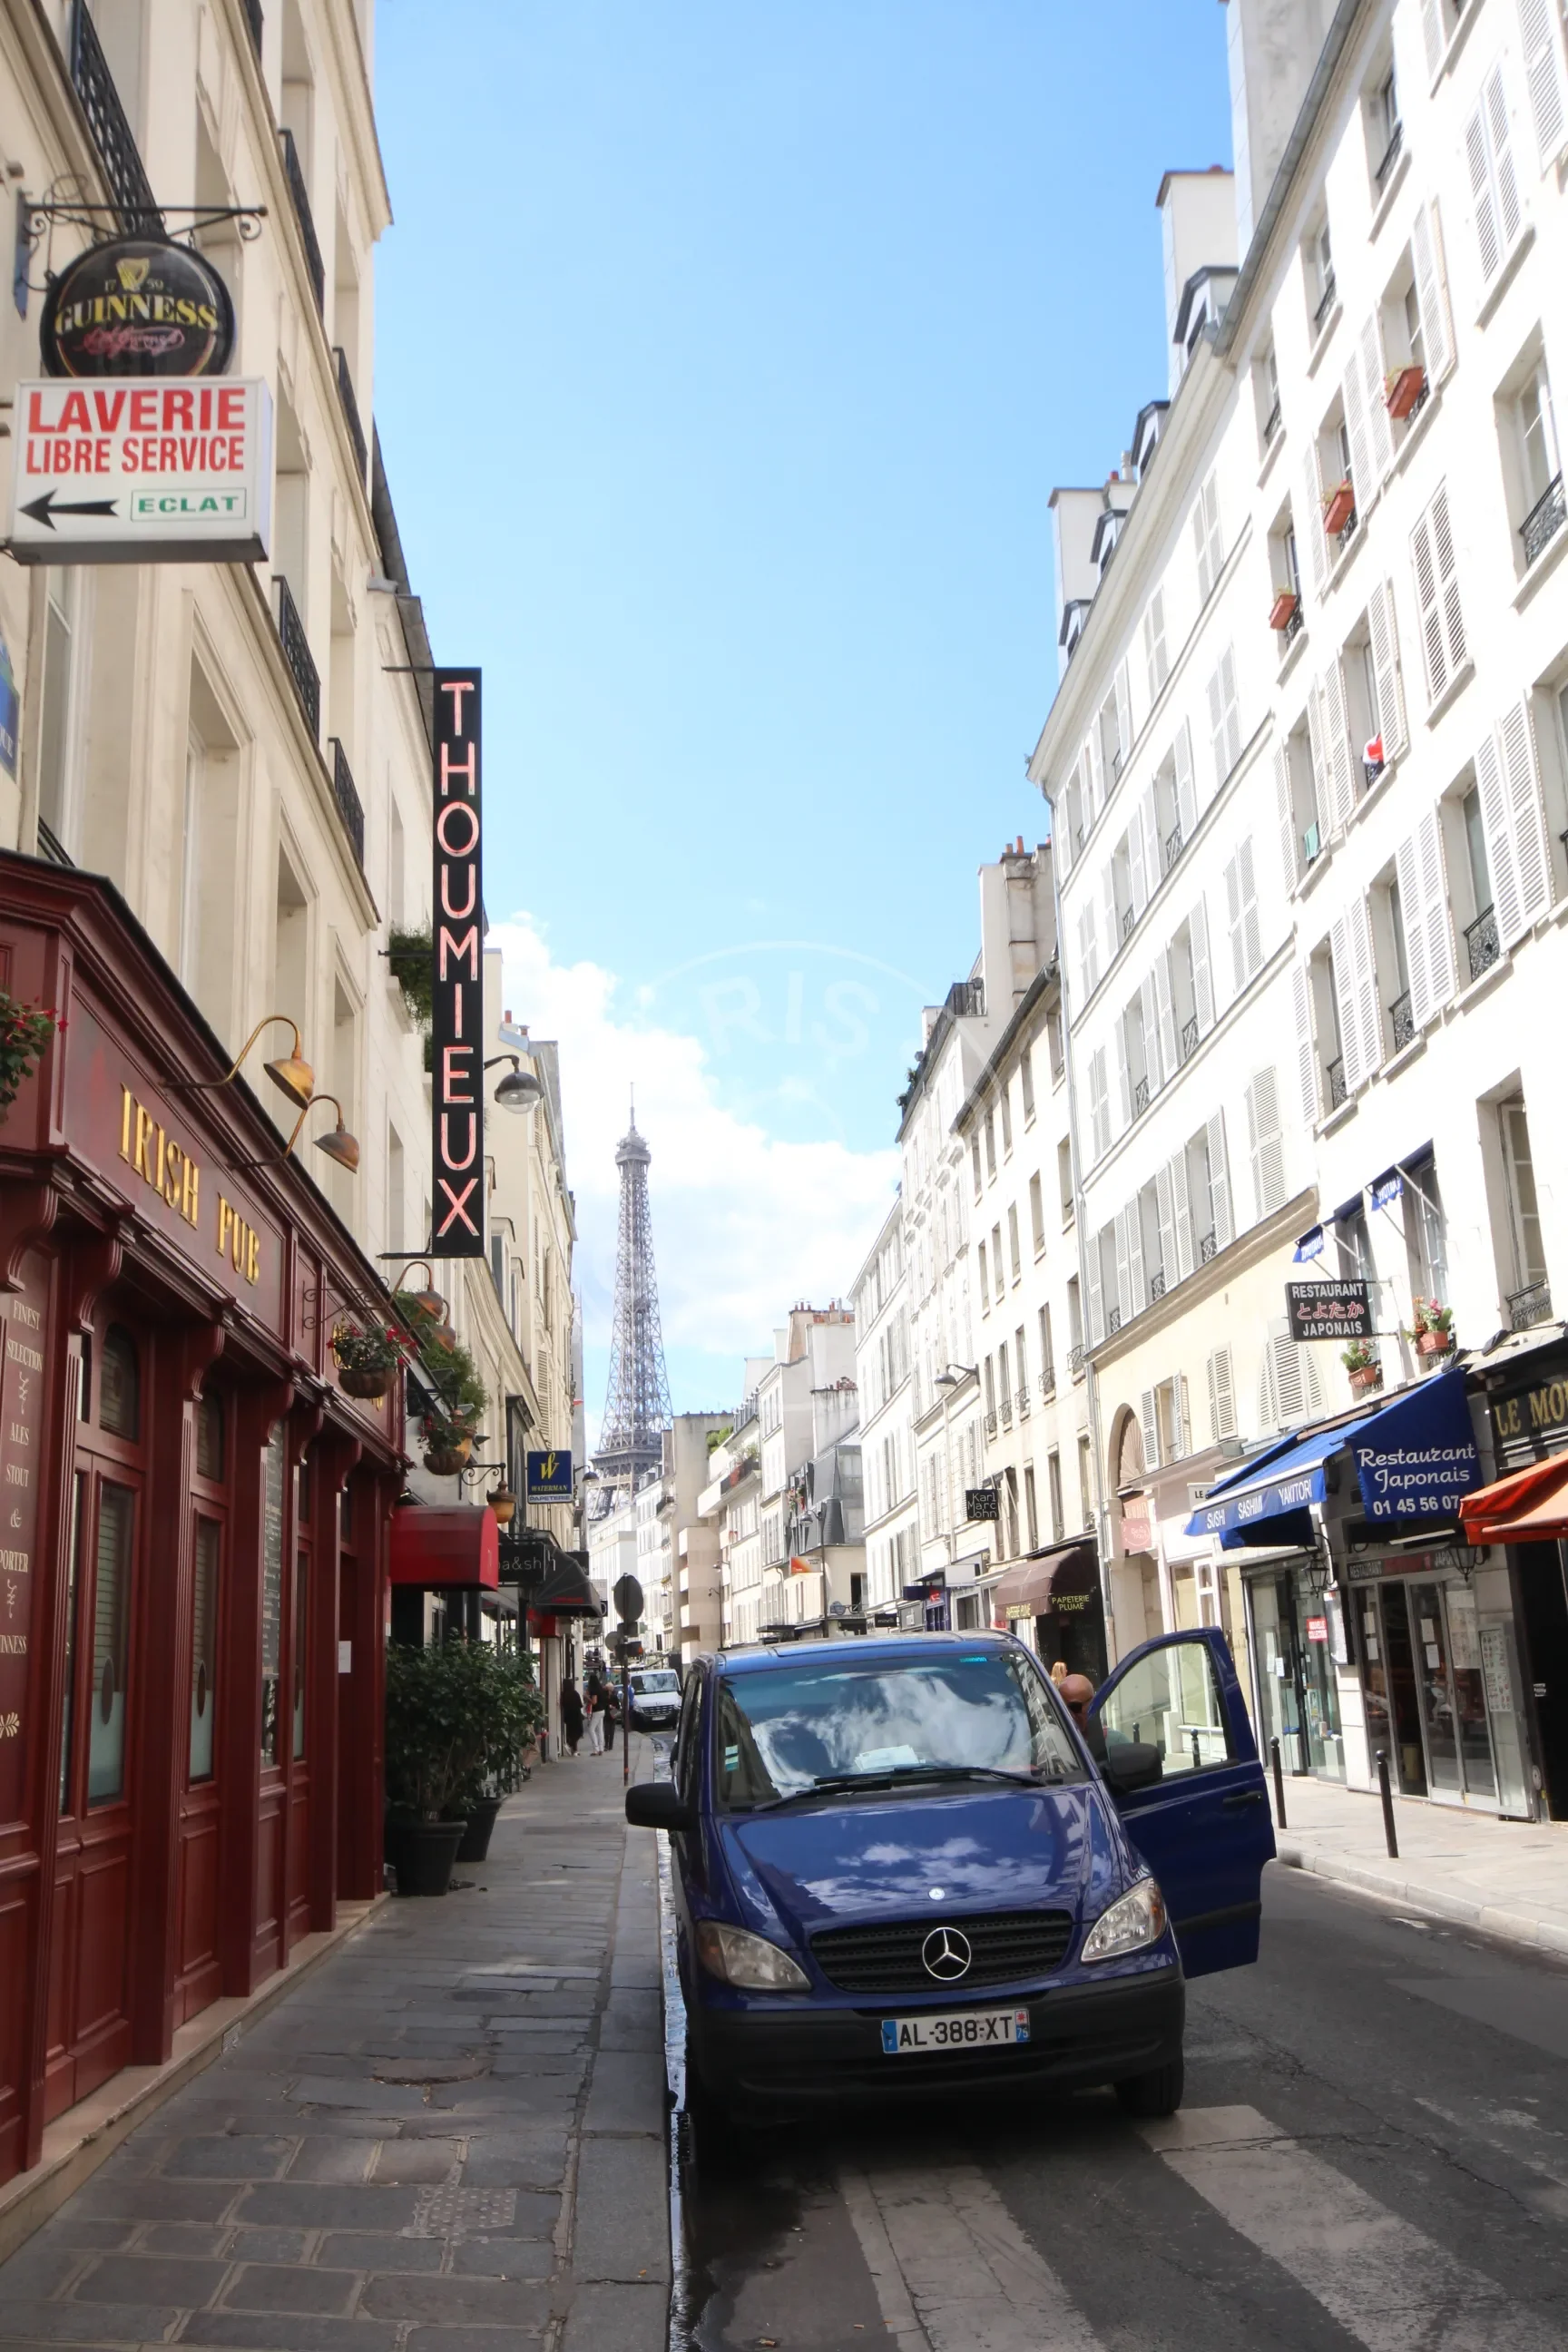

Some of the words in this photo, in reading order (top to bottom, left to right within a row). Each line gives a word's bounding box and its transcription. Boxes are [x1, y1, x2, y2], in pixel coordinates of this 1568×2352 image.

[54, 293, 219, 336] GUINNESS
[28, 388, 246, 434] LAVERIE
[26, 438, 111, 474] LIBRE
[122, 436, 244, 473] SERVICE
[138, 496, 240, 513] ECLAT
[436, 682, 479, 1237] THOUMIEUX
[118, 1082, 200, 1230] IRISH
[216, 1191, 260, 1286] PUB
[1291, 1282, 1364, 1298] RESTAURANT
[13, 1299, 41, 1331] FINEST
[1297, 1301, 1365, 1320] とよたか
[1302, 1321, 1363, 1337] JAPONAIS
[6, 1338, 44, 1373] SELECTION
[1494, 1397, 1522, 1436] LE
[10, 1422, 30, 1446] ALES
[1357, 1443, 1476, 1467] Restaurant
[6, 1463, 30, 1488] STOUT
[1375, 1466, 1470, 1494] Japonais
[967, 1500, 996, 1510] Marc
[972, 1492, 996, 1502] Karl
[1195, 1490, 1204, 1499] LE
[1207, 1509, 1225, 1529] SUSHI
[1238, 1494, 1263, 1519] SASHIMI
[1279, 1479, 1312, 1506] YAKITORI
[1373, 1500, 1391, 1515] 01
[1396, 1498, 1416, 1513] 45
[1419, 1496, 1438, 1512] 56
[1443, 1494, 1459, 1510] 07
[10, 1508, 22, 1528] &
[969, 1508, 997, 1518] John
[1052, 1595, 1090, 1604] PAPETERIE
[1059, 1602, 1084, 1612] PLUME
[899, 2016, 1013, 2047] AL-388-XT
